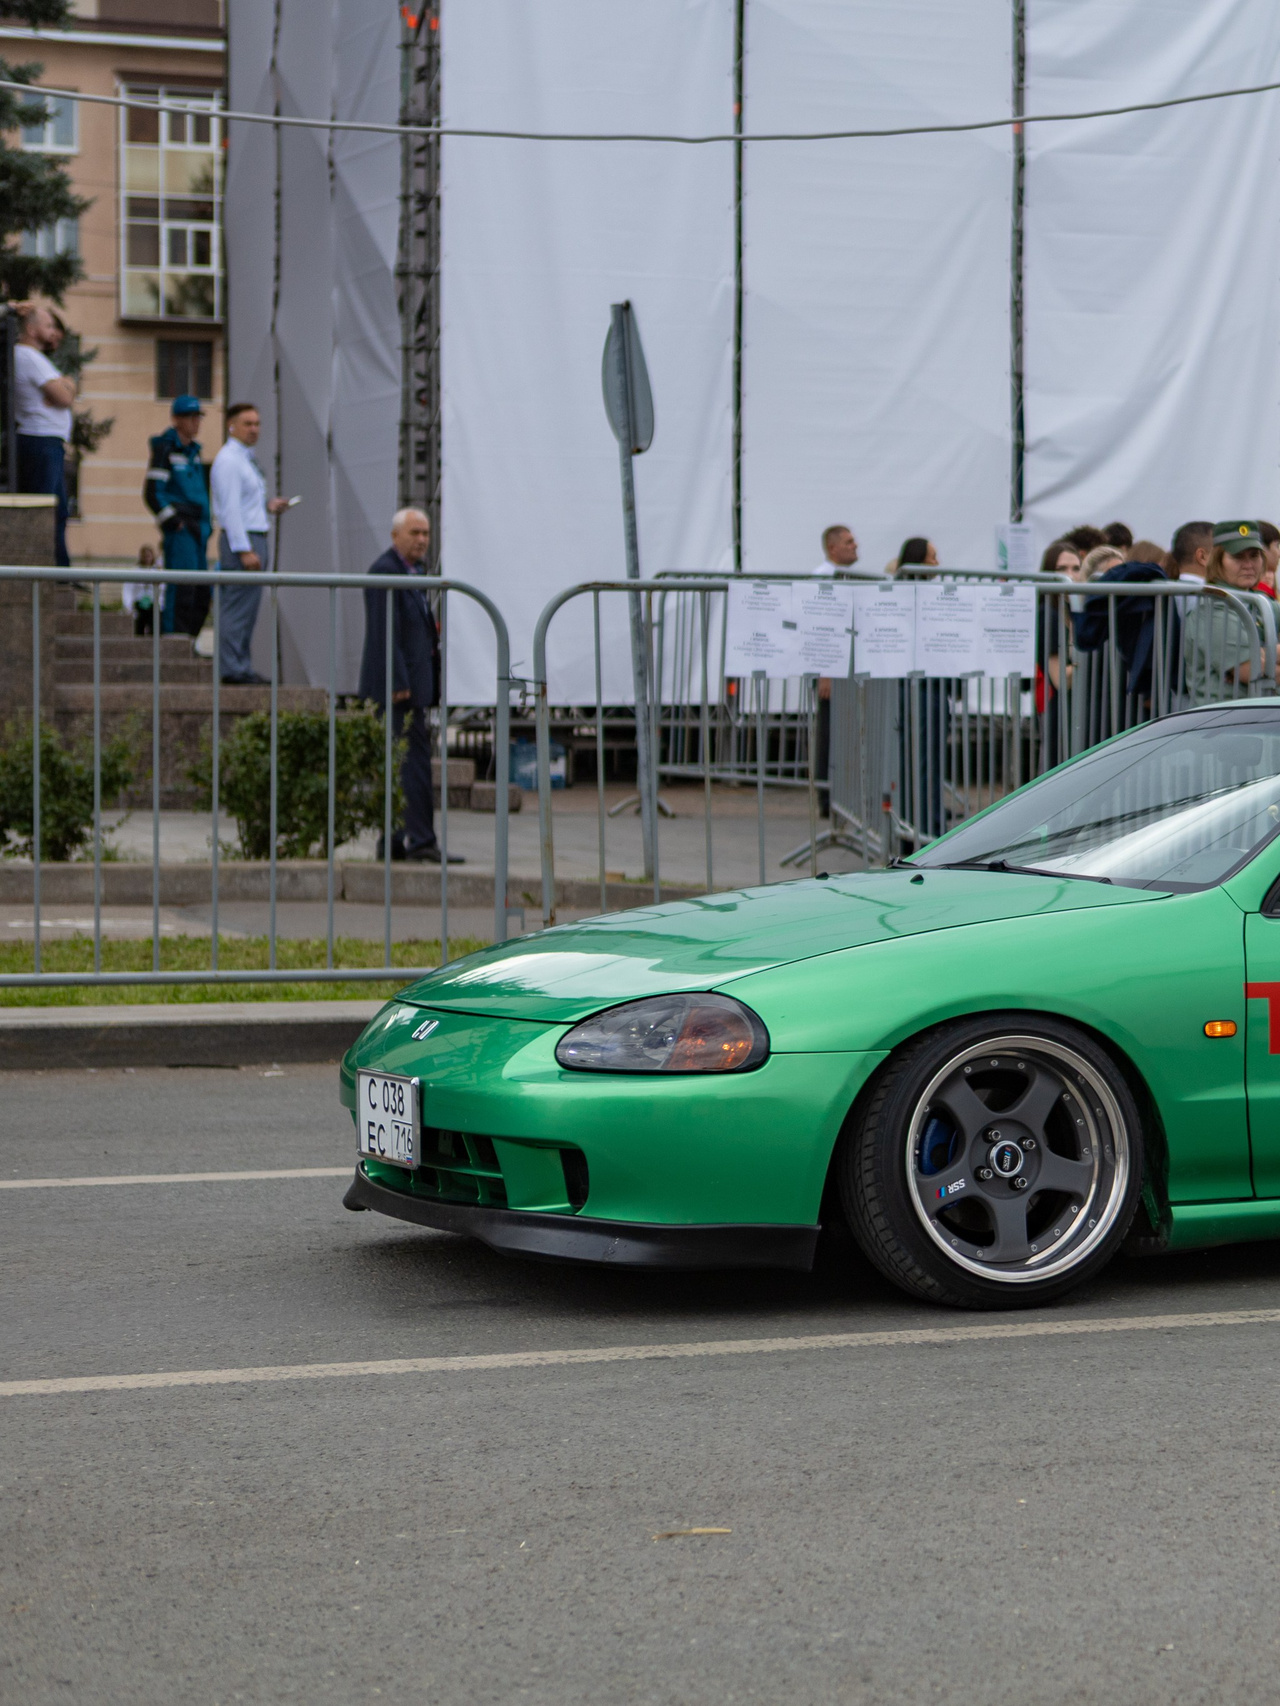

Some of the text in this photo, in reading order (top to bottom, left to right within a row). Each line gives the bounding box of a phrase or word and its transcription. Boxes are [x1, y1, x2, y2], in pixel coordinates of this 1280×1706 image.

[382, 1081, 405, 1116] 038
[394, 1124, 412, 1154] 716
[947, 1178, 966, 1194] SSR
